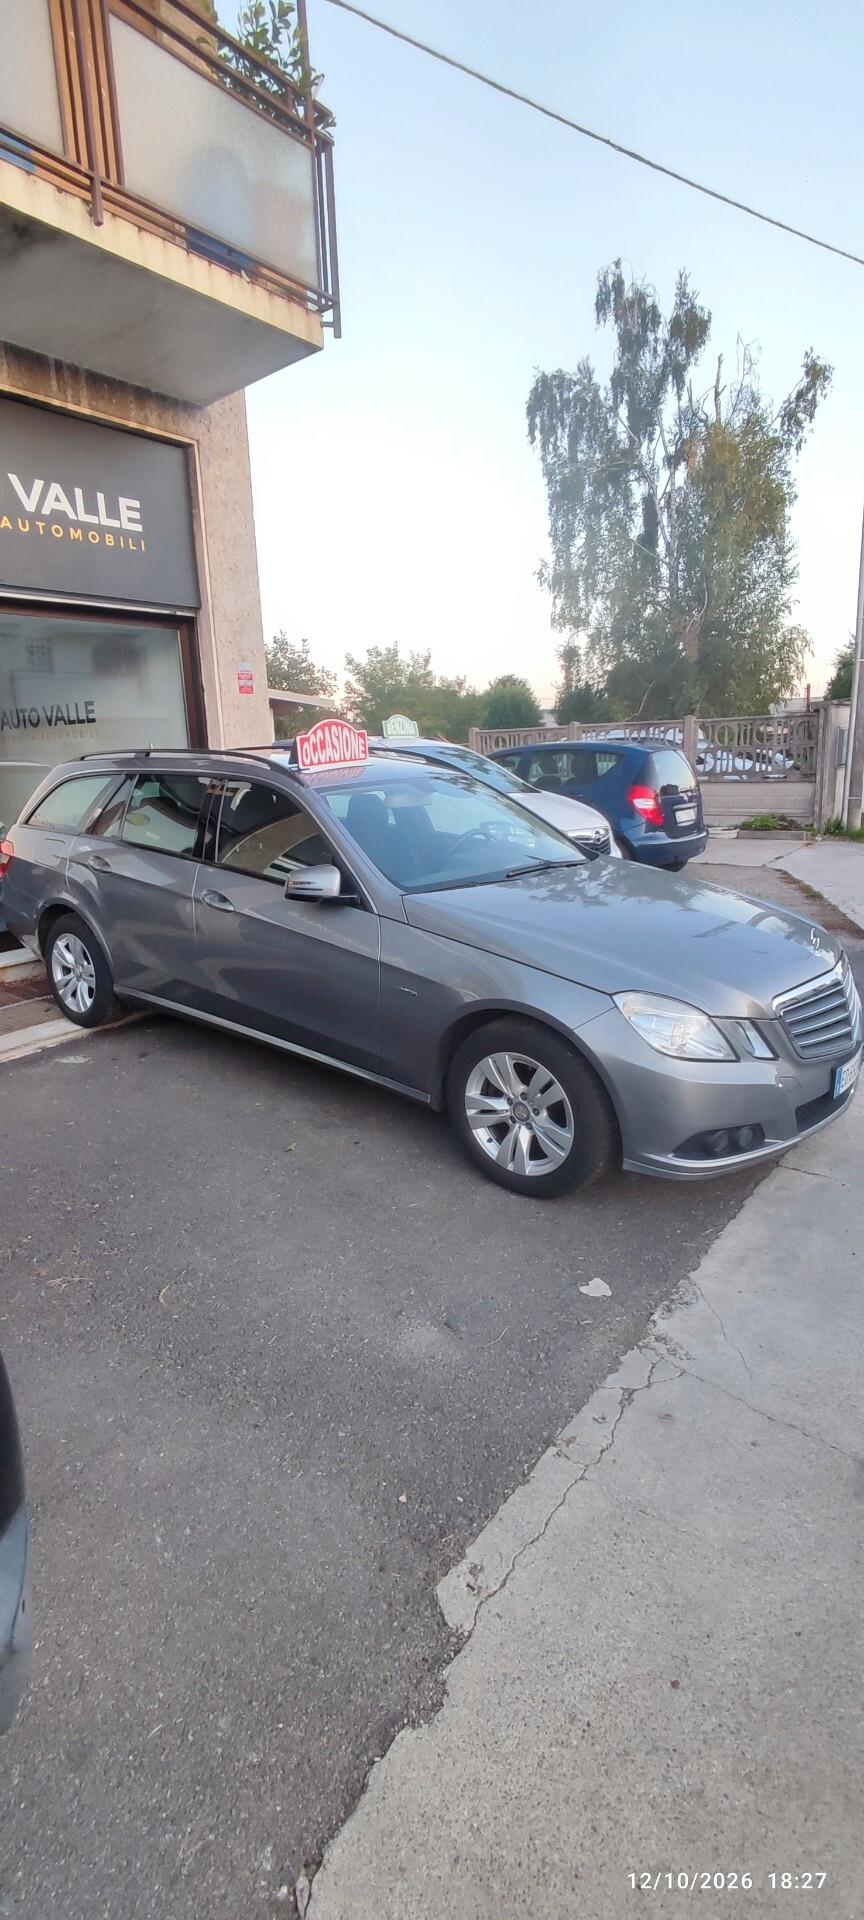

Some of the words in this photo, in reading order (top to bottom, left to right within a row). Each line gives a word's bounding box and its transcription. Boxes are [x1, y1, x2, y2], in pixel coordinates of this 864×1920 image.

[7, 472, 143, 532] VALLE
[0, 516, 146, 552] AUTOMOBILI
[0, 705, 40, 731] AUTO
[42, 700, 97, 727] VALLE
[302, 725, 366, 766] OCCASIONE
